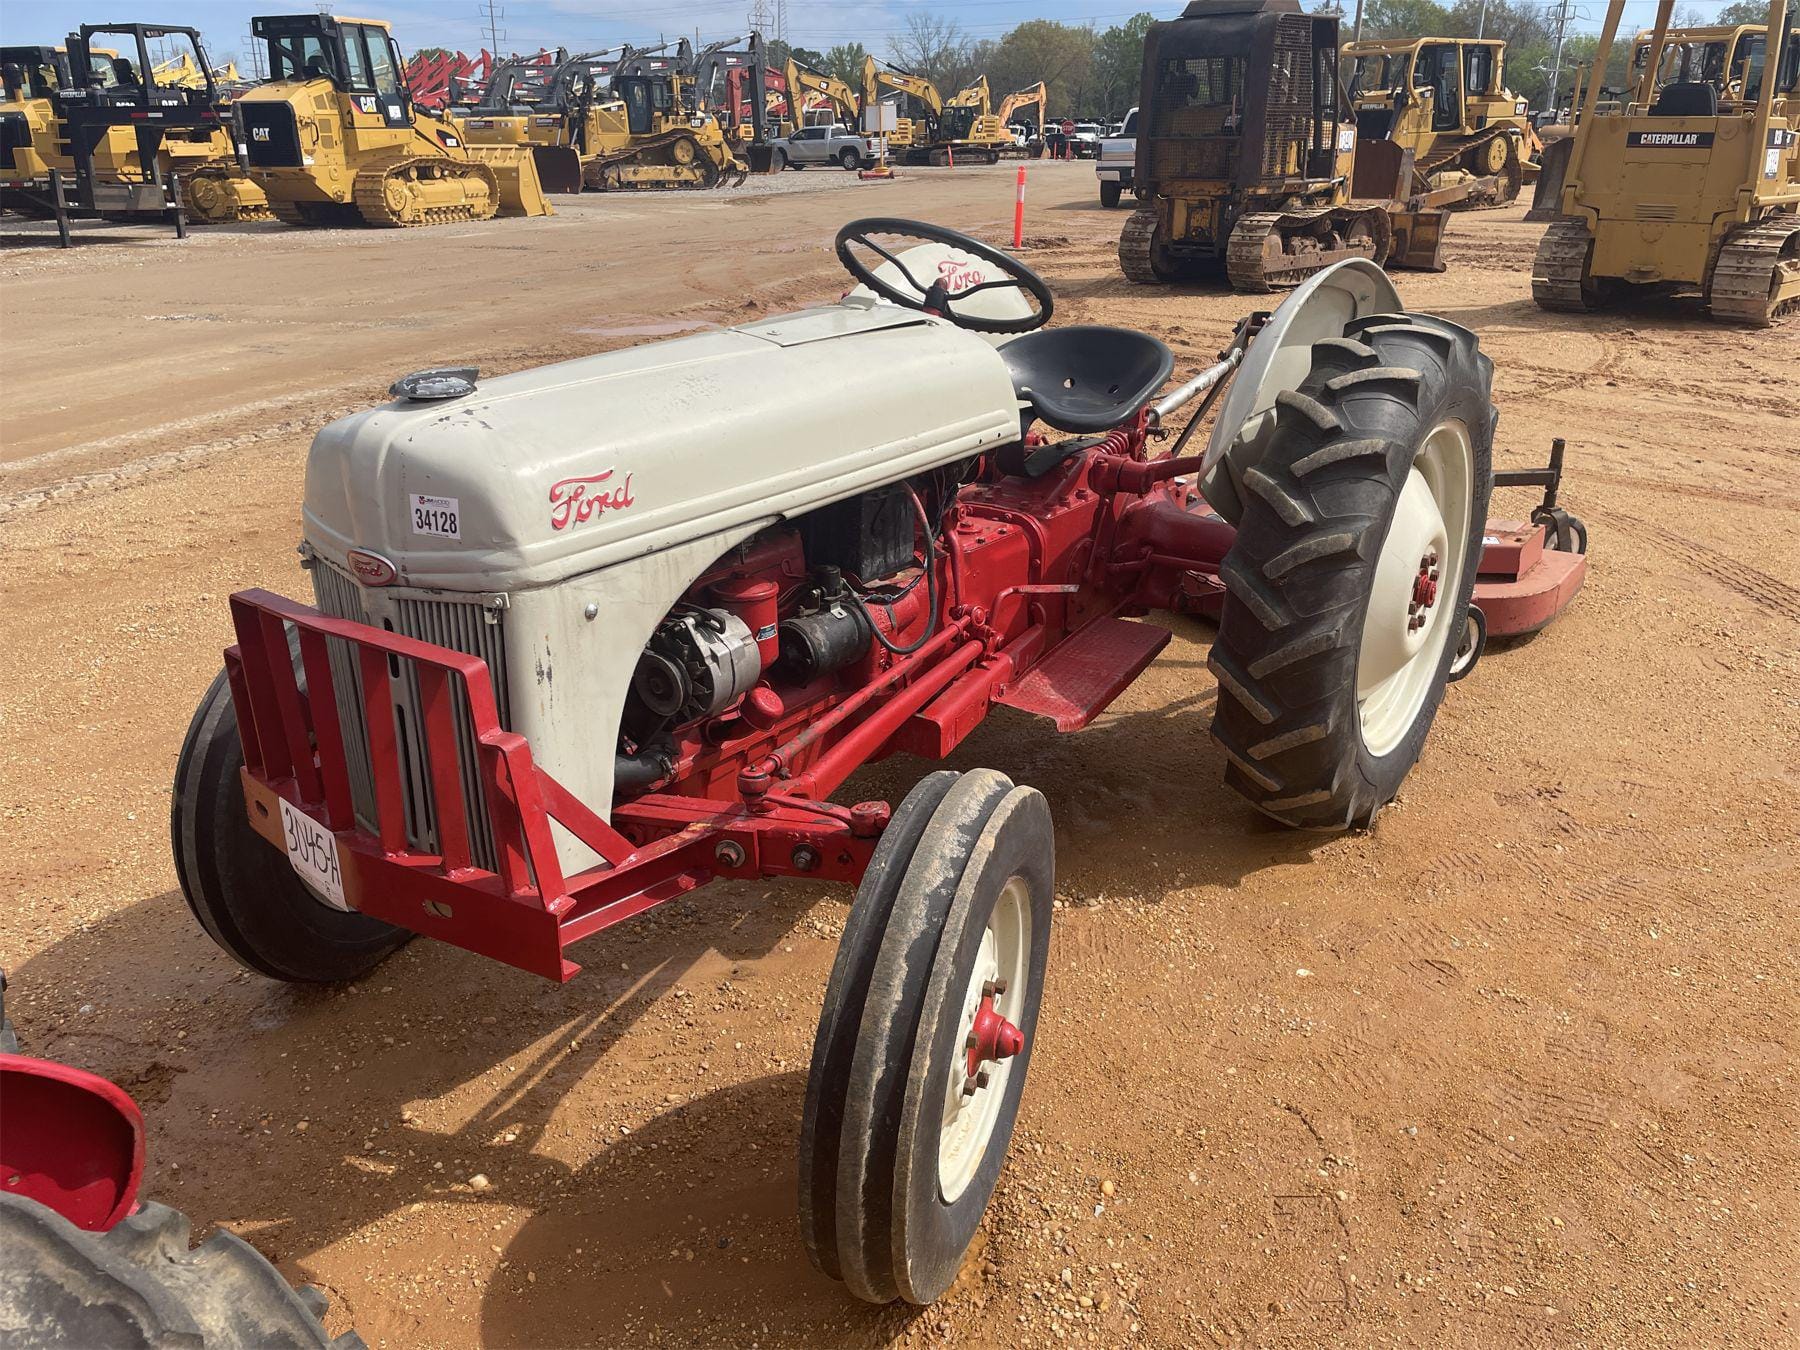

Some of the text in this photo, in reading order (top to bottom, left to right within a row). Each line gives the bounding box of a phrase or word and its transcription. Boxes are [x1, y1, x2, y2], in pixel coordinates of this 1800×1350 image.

[359, 96, 377, 113] CAT
[252, 127, 270, 142] CAT
[1062, 125, 1074, 134] STOP
[1640, 132, 1698, 145] CATERPILLAR
[549, 468, 635, 531] Ford
[415, 508, 458, 534] 34128
[353, 558, 383, 577] Ford
